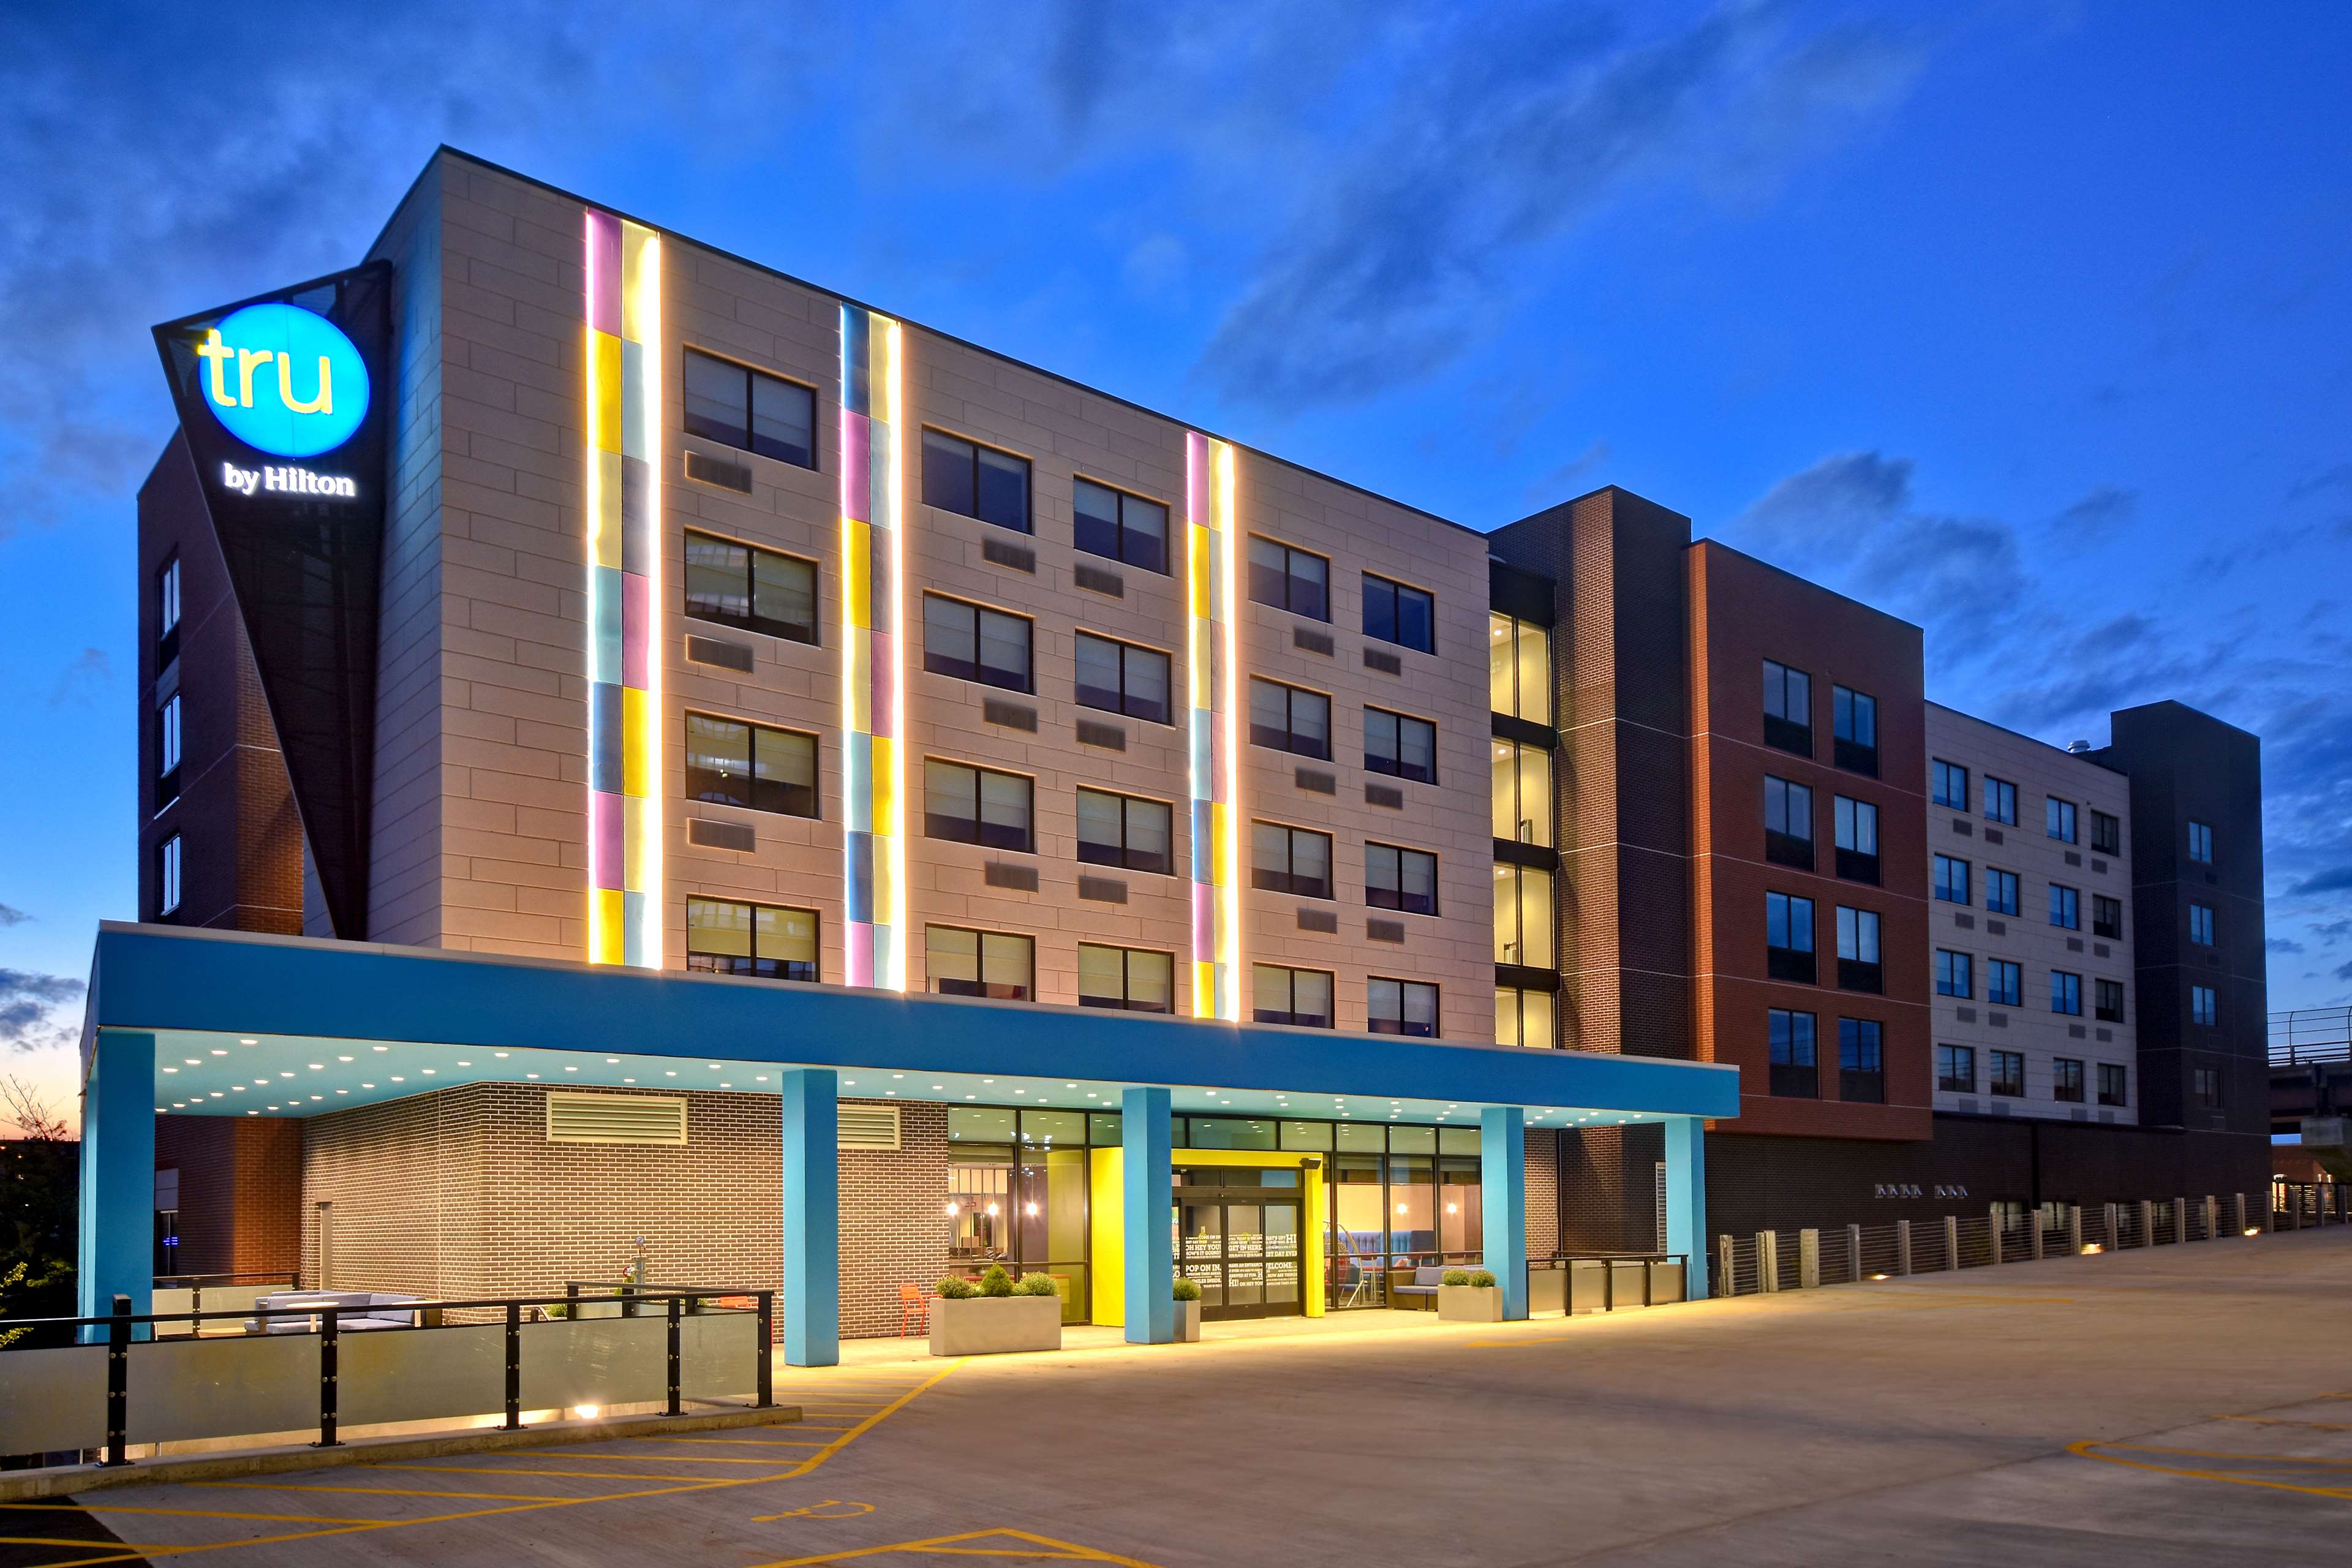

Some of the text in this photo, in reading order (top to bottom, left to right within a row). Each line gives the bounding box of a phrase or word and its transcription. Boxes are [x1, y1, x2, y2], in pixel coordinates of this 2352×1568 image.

[197, 328, 333, 415] tru
[224, 462, 355, 497] by Hilton
